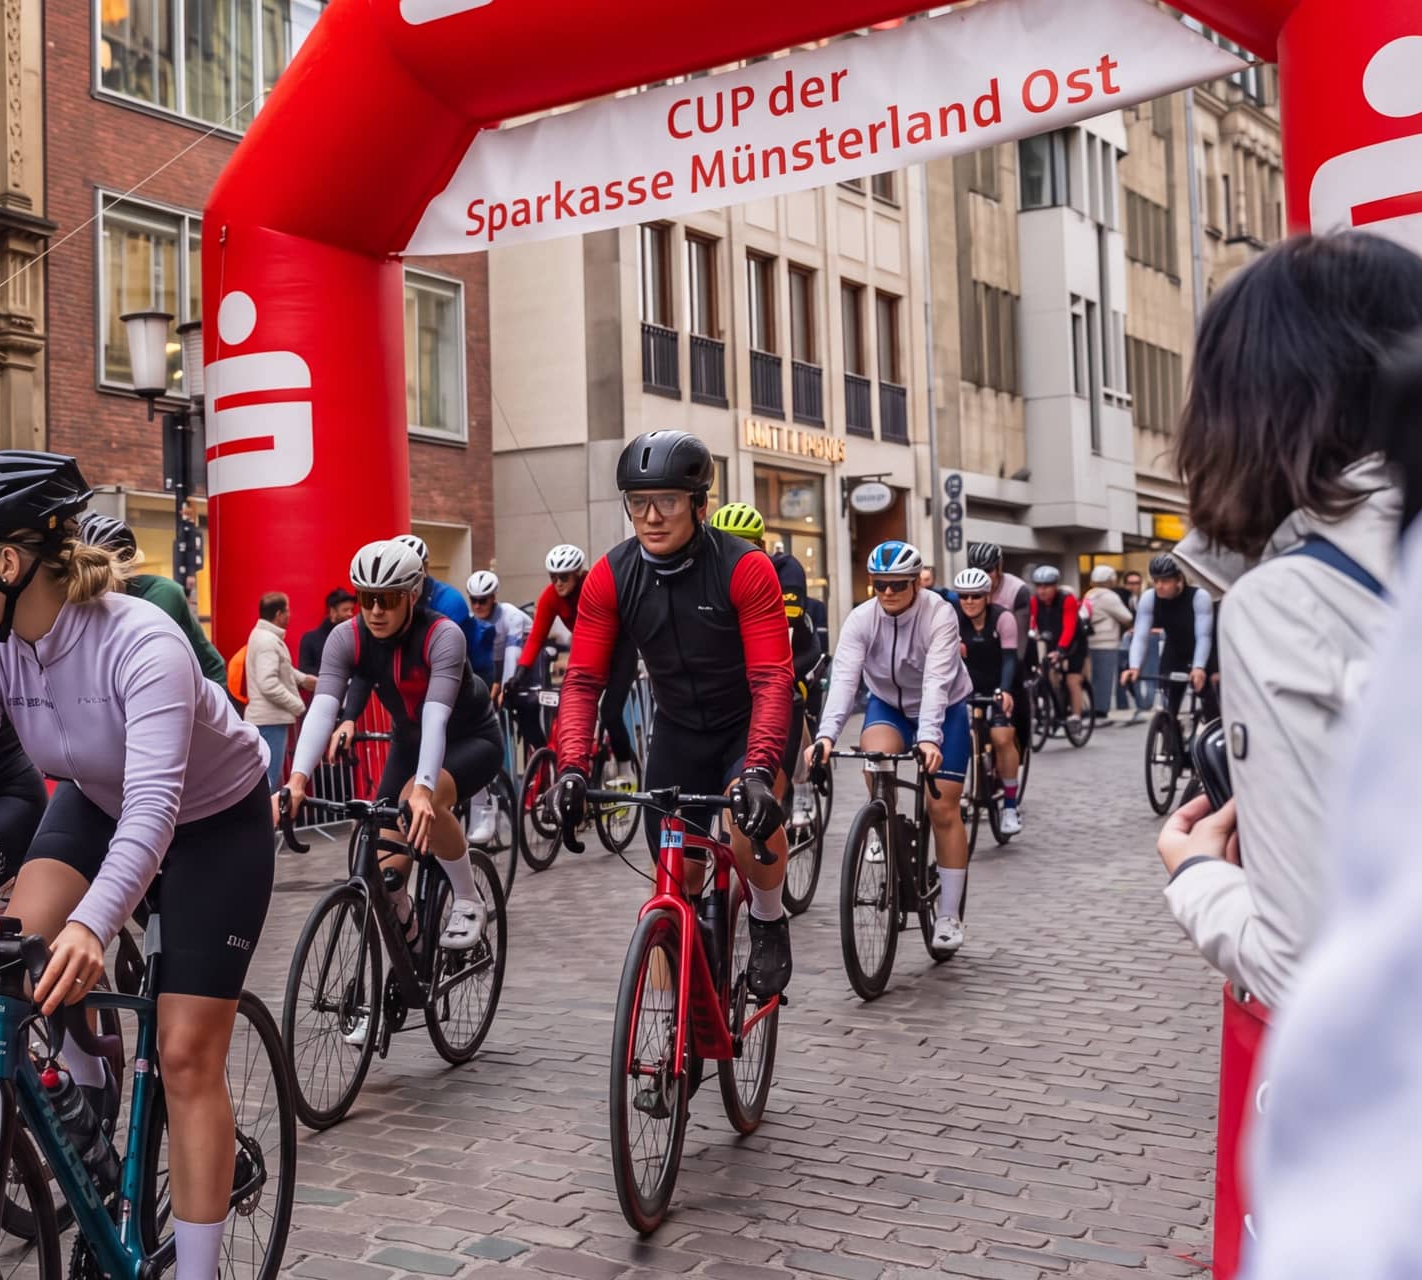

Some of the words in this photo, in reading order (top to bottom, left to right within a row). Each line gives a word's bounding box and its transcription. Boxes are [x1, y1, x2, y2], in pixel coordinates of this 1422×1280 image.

[465, 170, 675, 242] Sparkasse
[689, 77, 1003, 194] Münsterland
[1021, 54, 1121, 114] Ost
[667, 86, 755, 140] CUP
[768, 69, 849, 117] der
